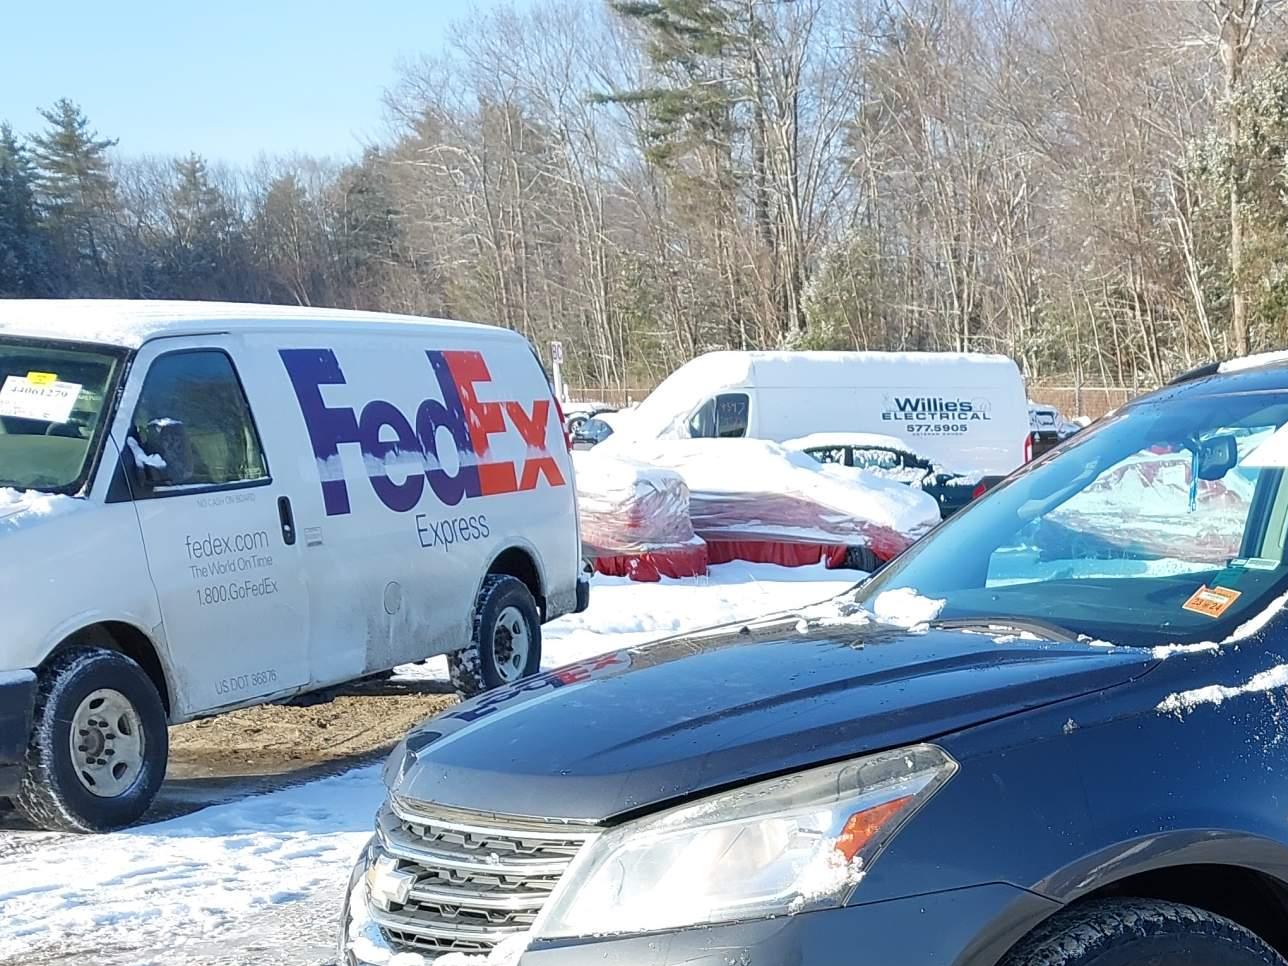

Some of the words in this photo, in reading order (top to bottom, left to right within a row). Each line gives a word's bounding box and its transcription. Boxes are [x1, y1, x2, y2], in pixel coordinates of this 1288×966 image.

[881, 412, 991, 420] ELECTRICAL
[894, 397, 973, 412] Willie's
[278, 348, 567, 516] FedEx
[906, 424, 967, 432] 577.5905
[415, 513, 490, 552] Express
[185, 531, 269, 559] fedex.com
[190, 565, 208, 578] The
[208, 559, 236, 576] World
[237, 556, 252, 571] On
[251, 555, 273, 569] Time
[196, 577, 278, 606] 1.800.GoFedEx
[215, 680, 229, 694] US
[230, 675, 248, 691] DOT
